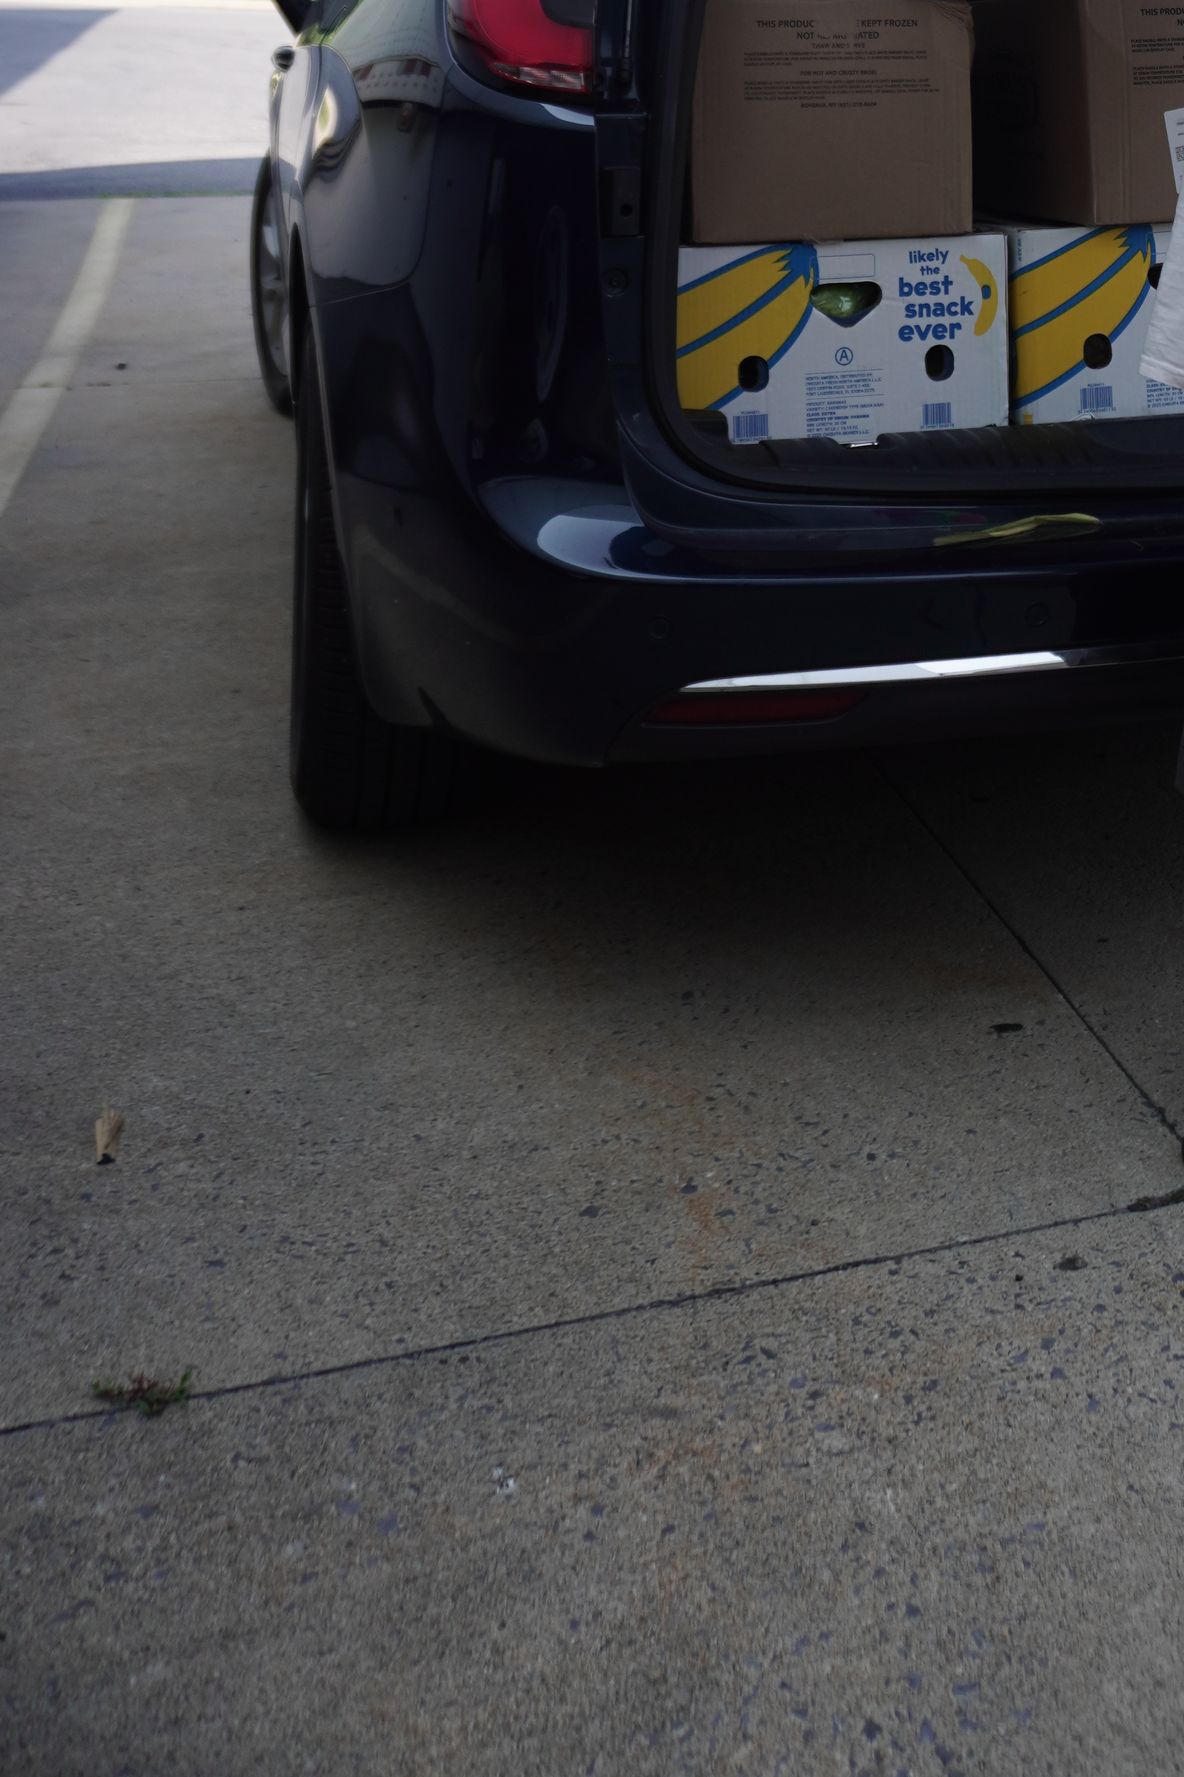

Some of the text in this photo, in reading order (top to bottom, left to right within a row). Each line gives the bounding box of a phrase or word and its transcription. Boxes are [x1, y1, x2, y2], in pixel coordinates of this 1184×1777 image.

[1140, 8, 1158, 16] THIS
[756, 19, 918, 28] THIS PRODUC KEPT FROZEN
[796, 32, 814, 40] NOT
[908, 248, 949, 264] likely
[920, 264, 940, 275] the
[898, 275, 954, 297] best
[904, 296, 974, 318] snack
[898, 321, 962, 342] ever
